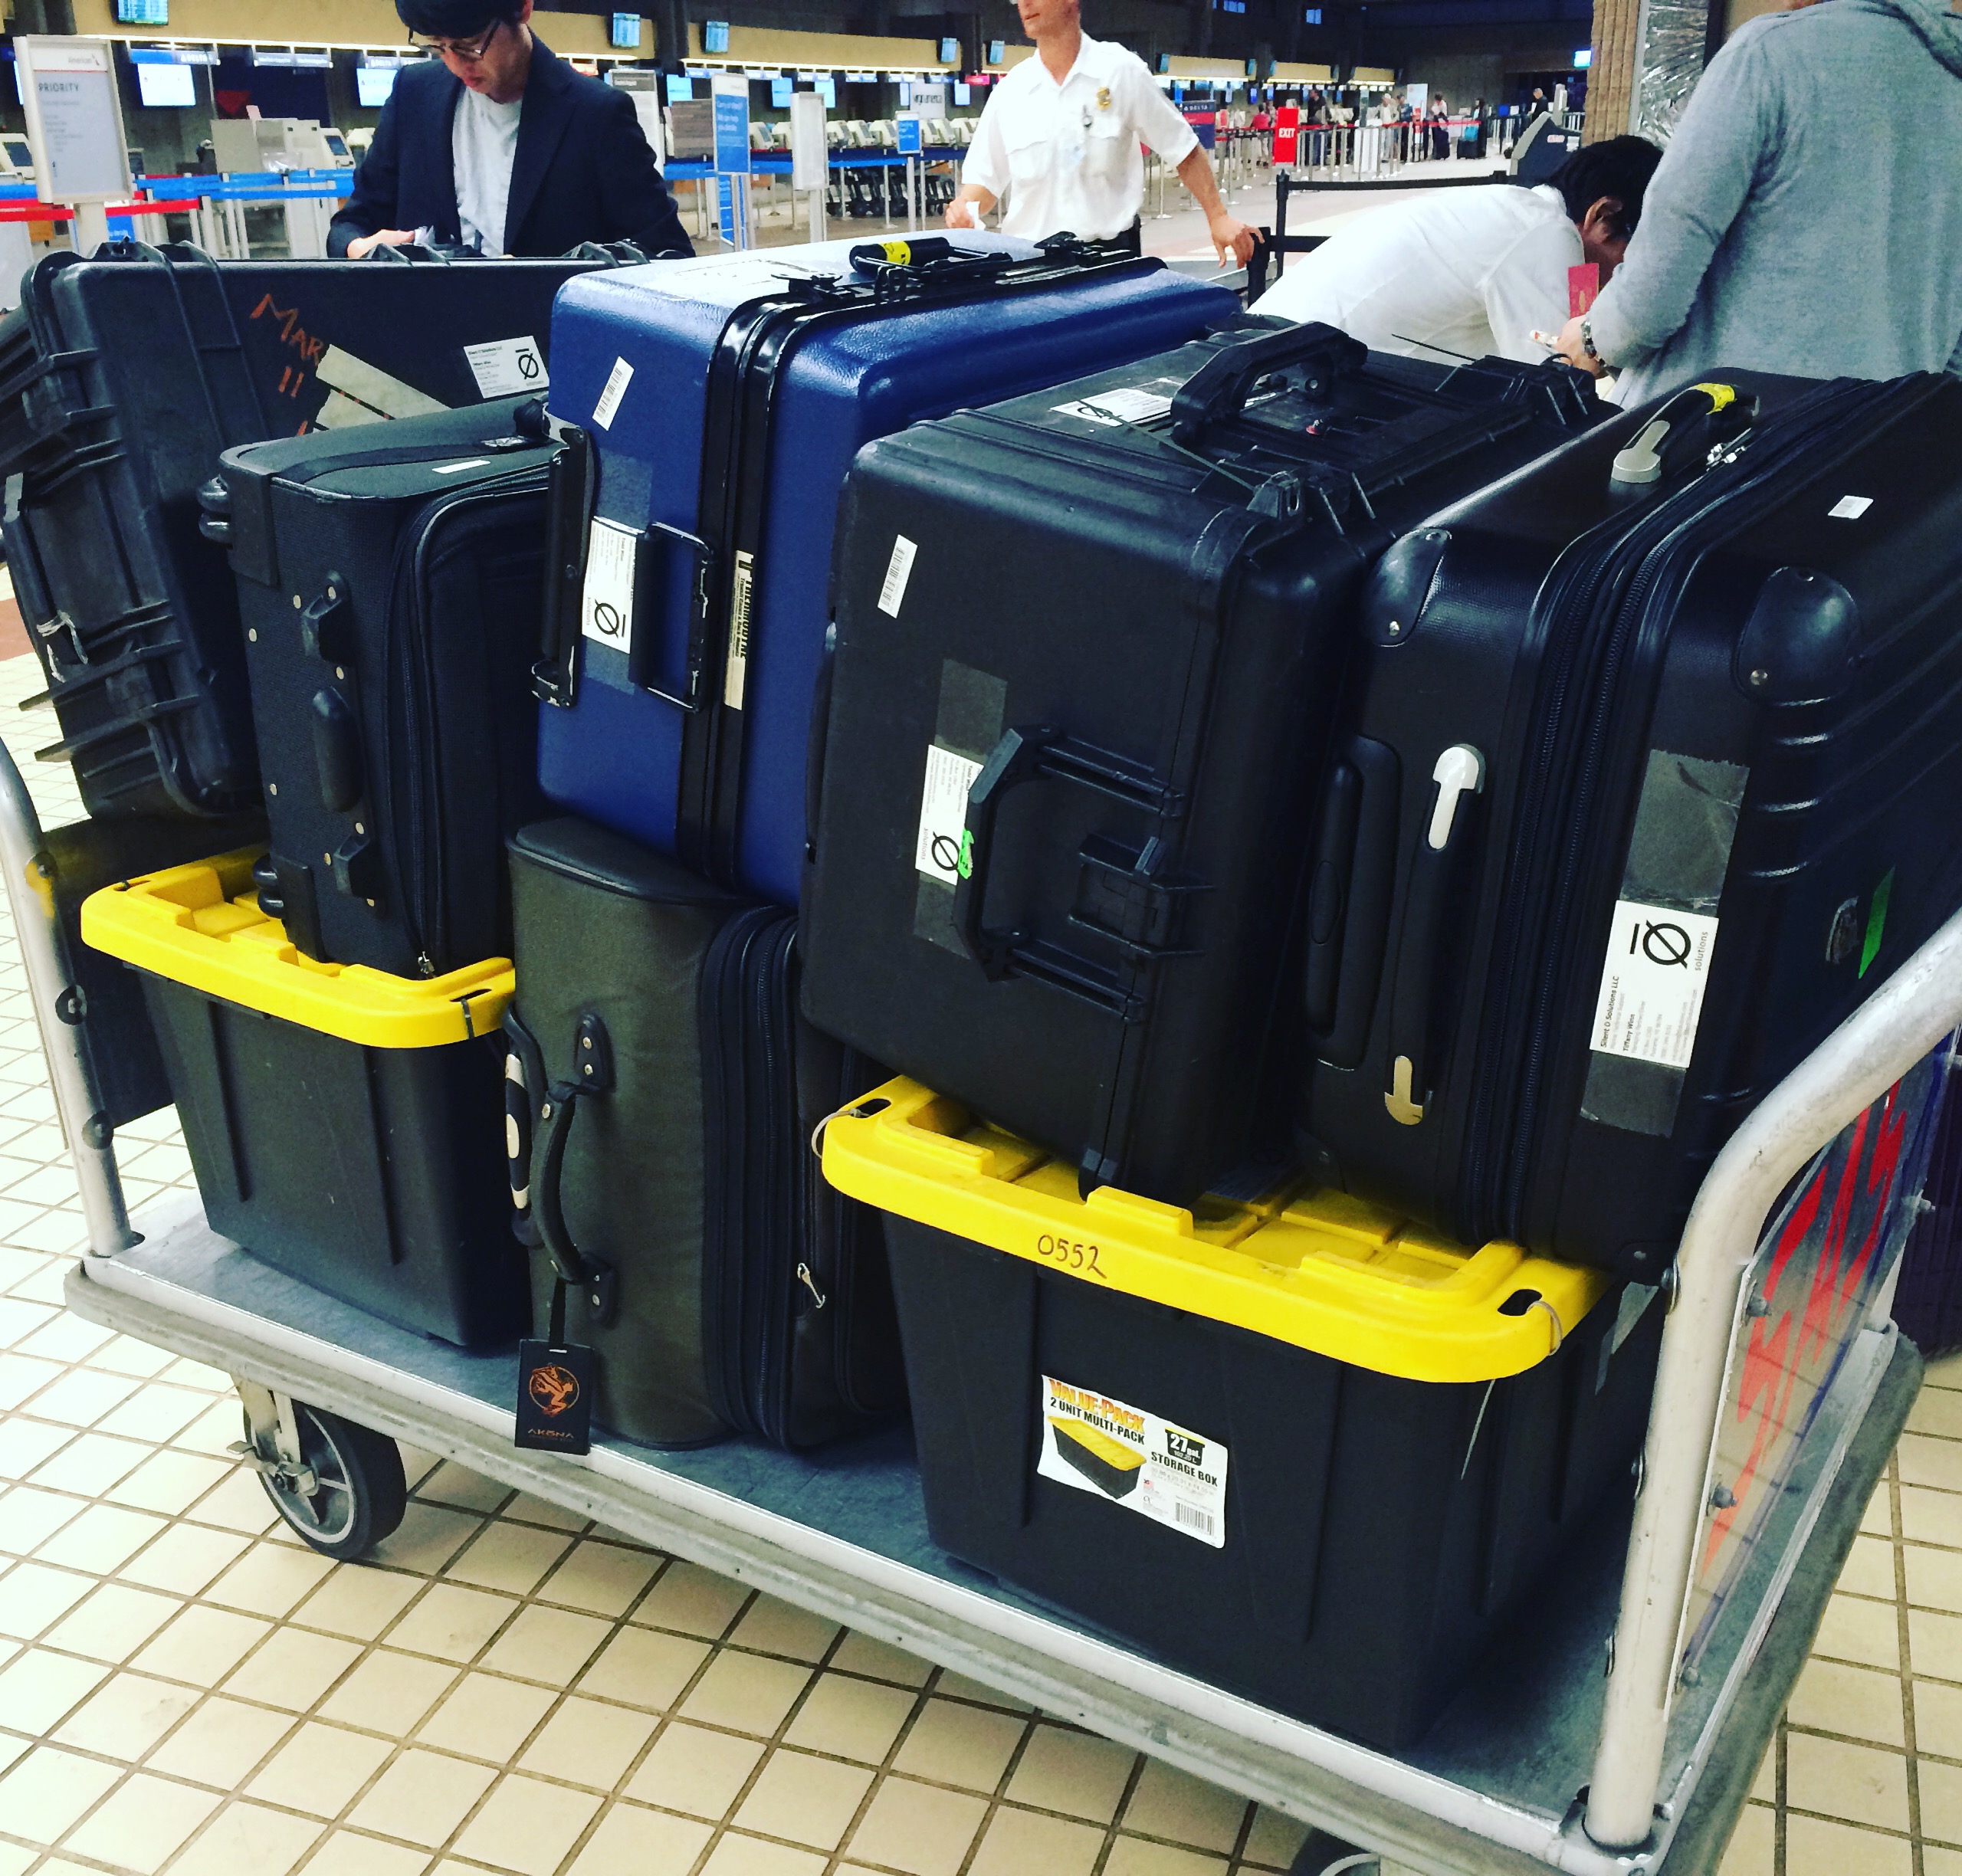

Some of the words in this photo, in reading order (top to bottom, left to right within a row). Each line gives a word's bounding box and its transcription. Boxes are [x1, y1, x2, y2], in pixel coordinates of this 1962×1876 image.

[38, 82, 79, 92] PRIORITY
[1278, 127, 1296, 139] EXIT
[920, 827, 930, 861] solutions
[1695, 931, 1708, 971] solutions
[1611, 975, 1619, 989] LLC
[1606, 989, 1617, 1020] Solutions
[1600, 1027, 1609, 1048] Silent
[1622, 1030, 1633, 1052] Tiffany
[1038, 1235, 1107, 1279] 0552
[1048, 1379, 1145, 1435] VALUE-PACK
[1050, 1396, 1058, 1409] 2
[1059, 1400, 1082, 1418] UNIT
[1084, 1411, 1145, 1445] MULTI-PACK
[1170, 1433, 1189, 1453] 27
[1151, 1451, 1196, 1478] STORAGE
[1198, 1471, 1219, 1487] BOX
